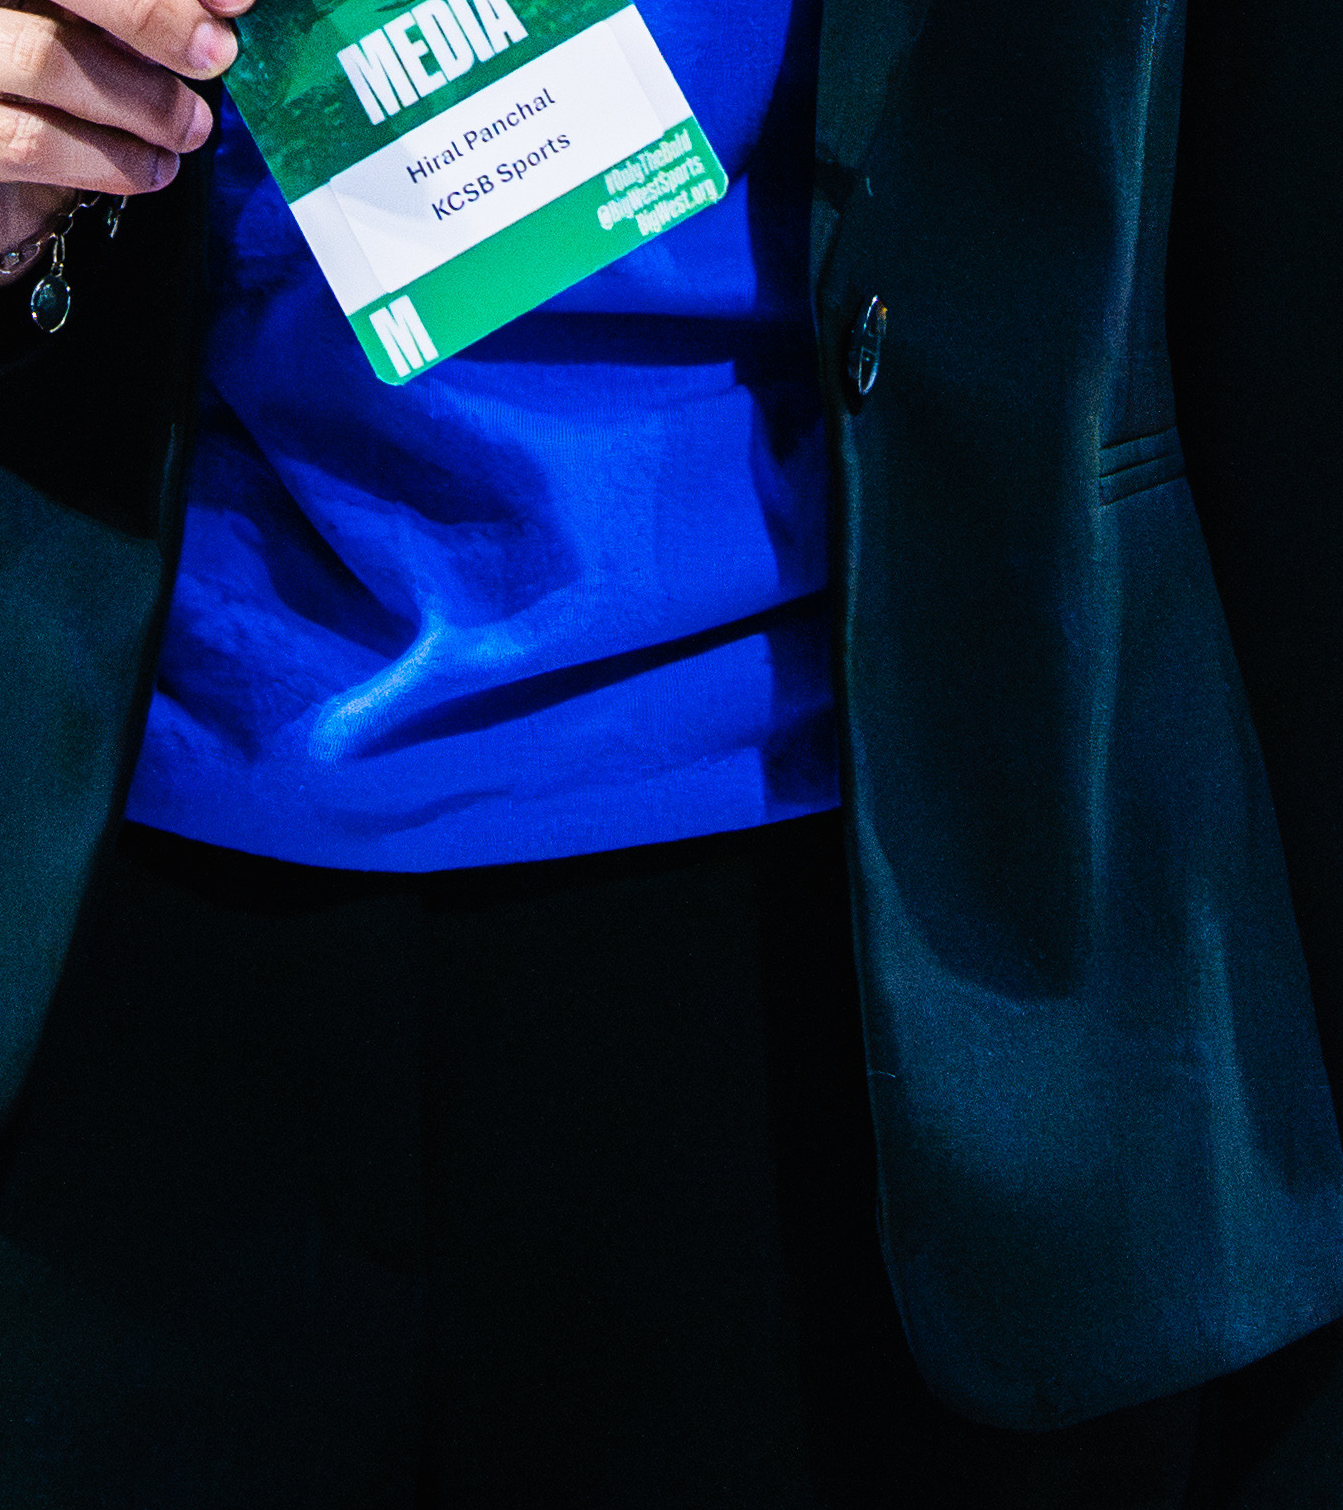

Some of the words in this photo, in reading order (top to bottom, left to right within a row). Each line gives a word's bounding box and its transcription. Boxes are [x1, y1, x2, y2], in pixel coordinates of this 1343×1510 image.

[407, 141, 464, 183] Hiral
[463, 88, 555, 150] Panchal
[432, 175, 494, 220] KCSB
[496, 134, 571, 180] Sports
[635, 179, 717, 236] BigWest.org
[369, 295, 439, 377] M
